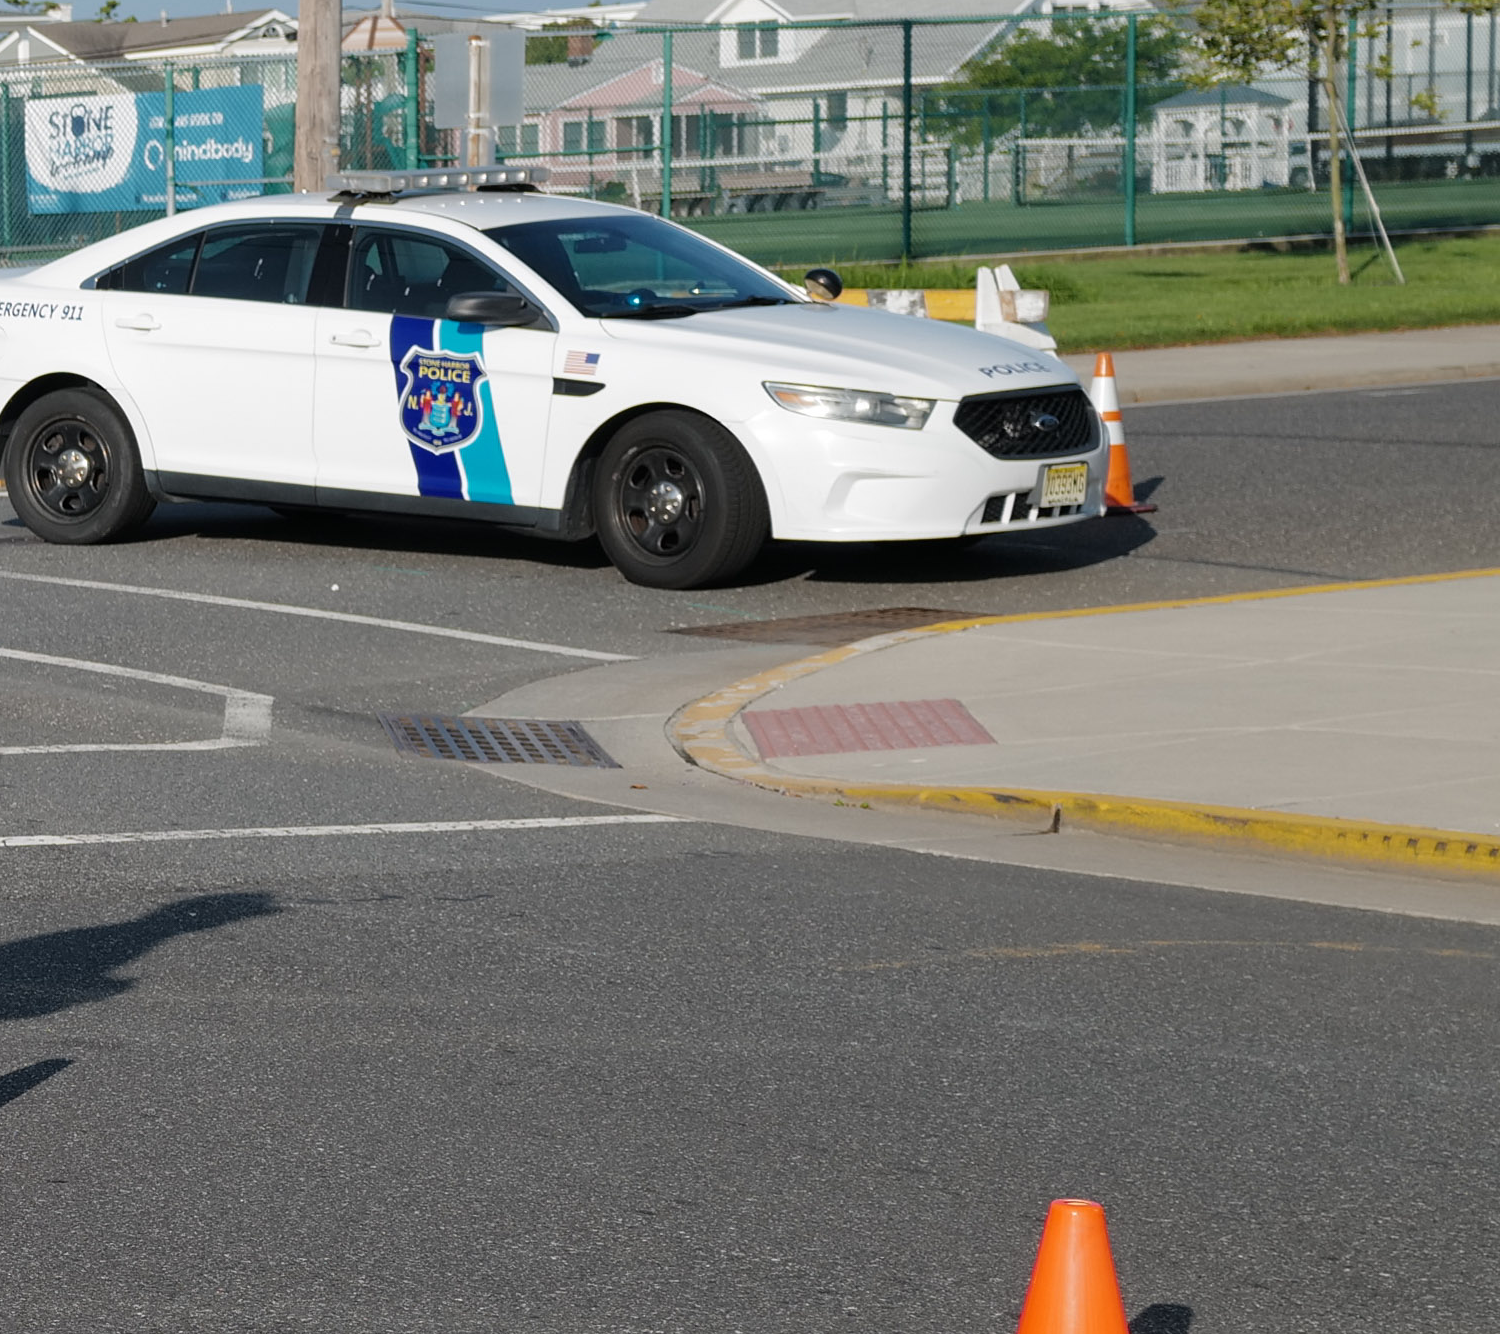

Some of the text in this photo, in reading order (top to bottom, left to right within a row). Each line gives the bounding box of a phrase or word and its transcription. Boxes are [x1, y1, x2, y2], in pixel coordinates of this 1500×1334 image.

[60, 305, 84, 321] 911
[418, 366, 471, 384] POLICE
[979, 361, 1052, 378] POLICE
[407, 394, 419, 410] N.
